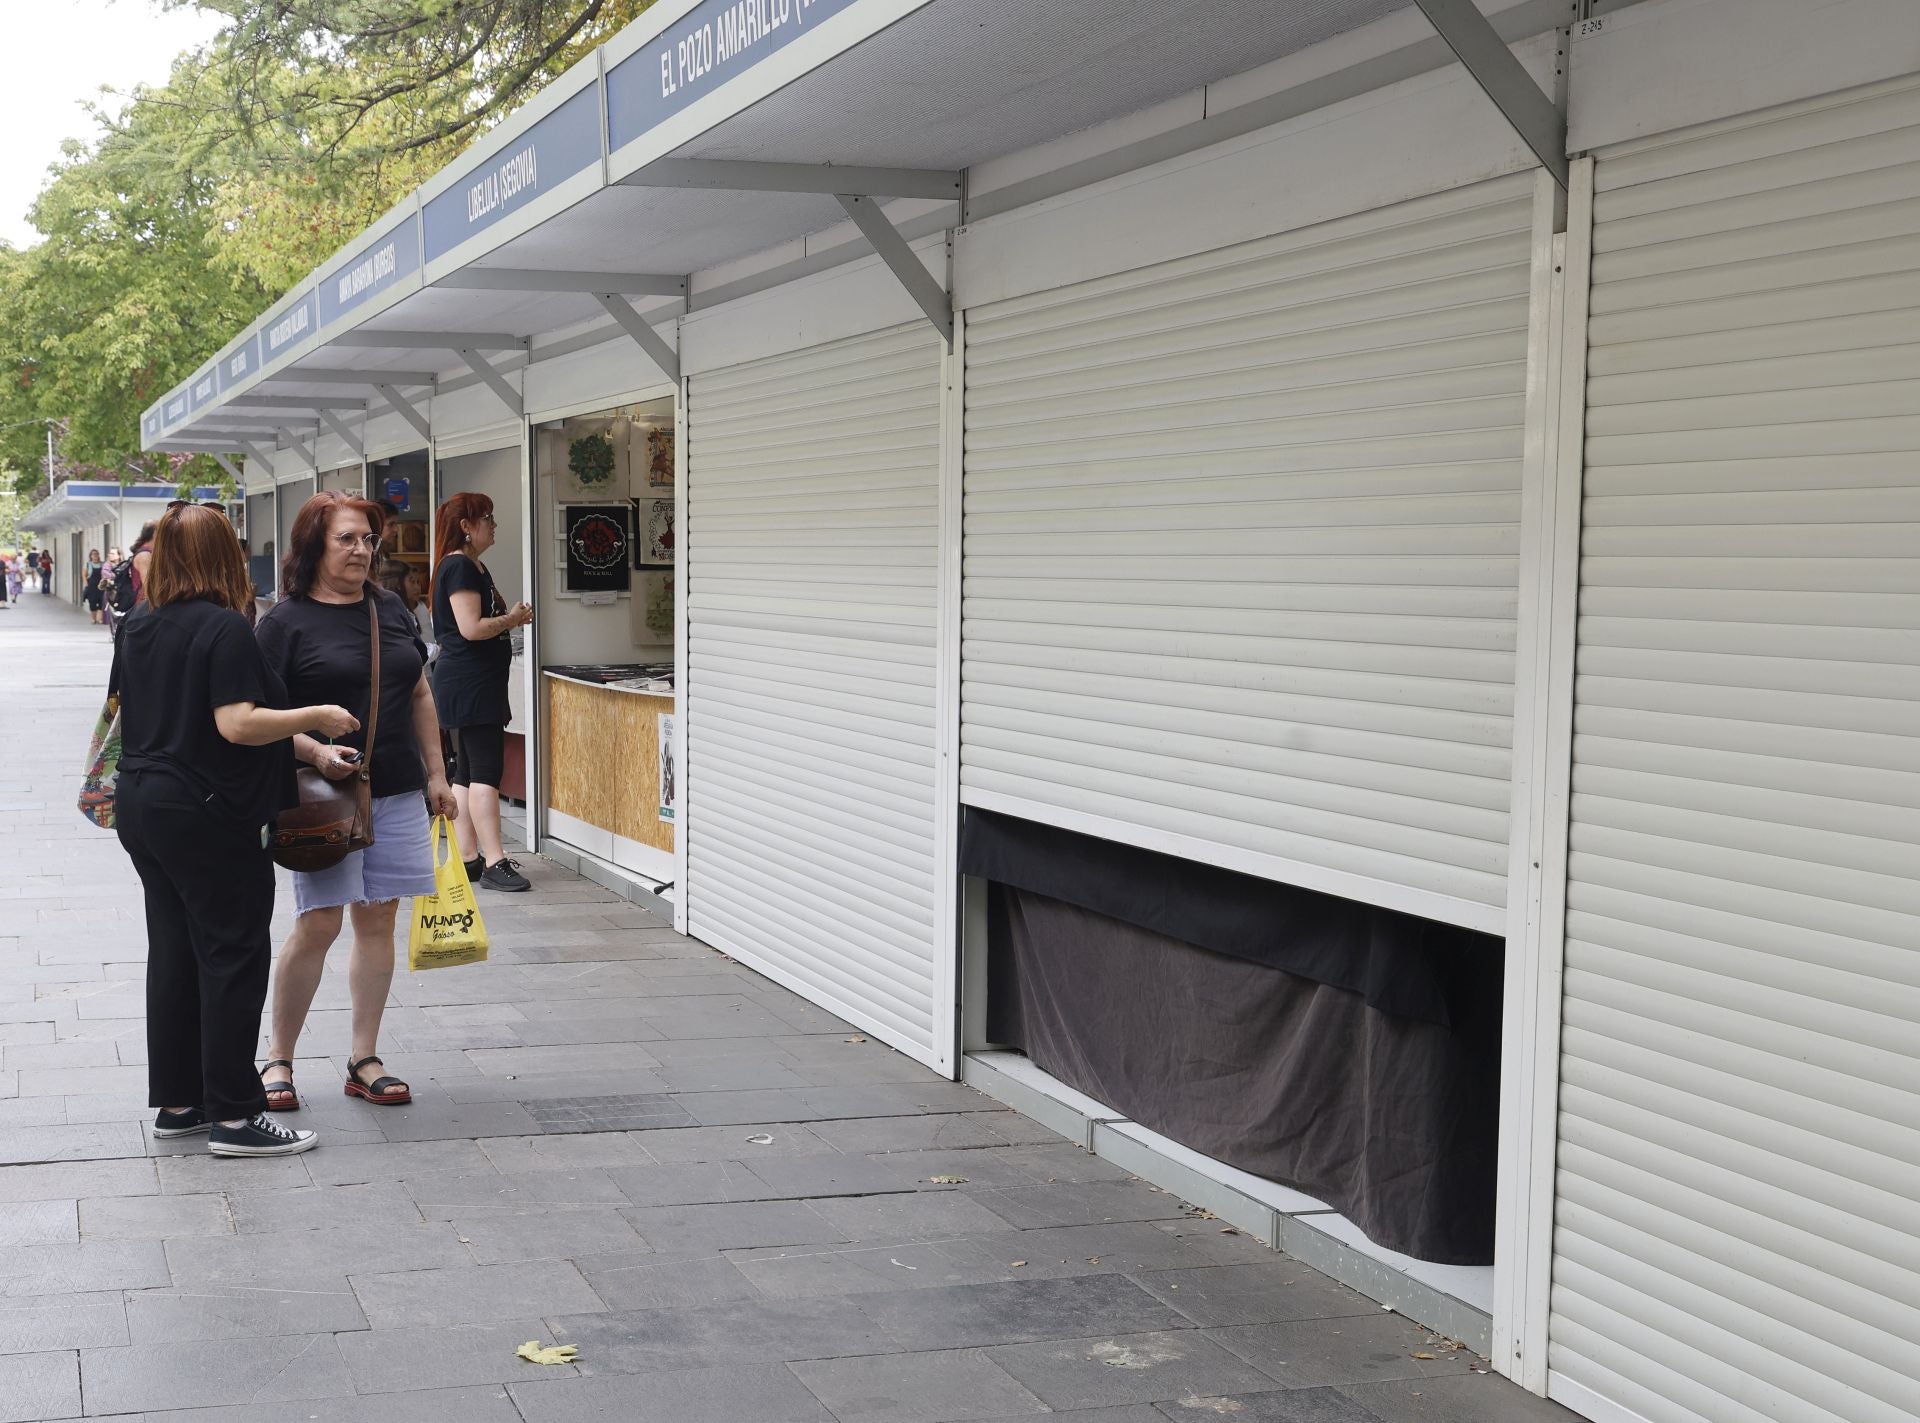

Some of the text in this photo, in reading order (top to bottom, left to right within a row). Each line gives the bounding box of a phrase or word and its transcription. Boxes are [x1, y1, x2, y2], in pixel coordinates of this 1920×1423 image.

[660, 49, 677, 98] EL
[678, 23, 712, 88] POZO
[467, 144, 537, 222] LIBELULA (SEGOVIA)
[420, 913, 474, 928] MUNDO
